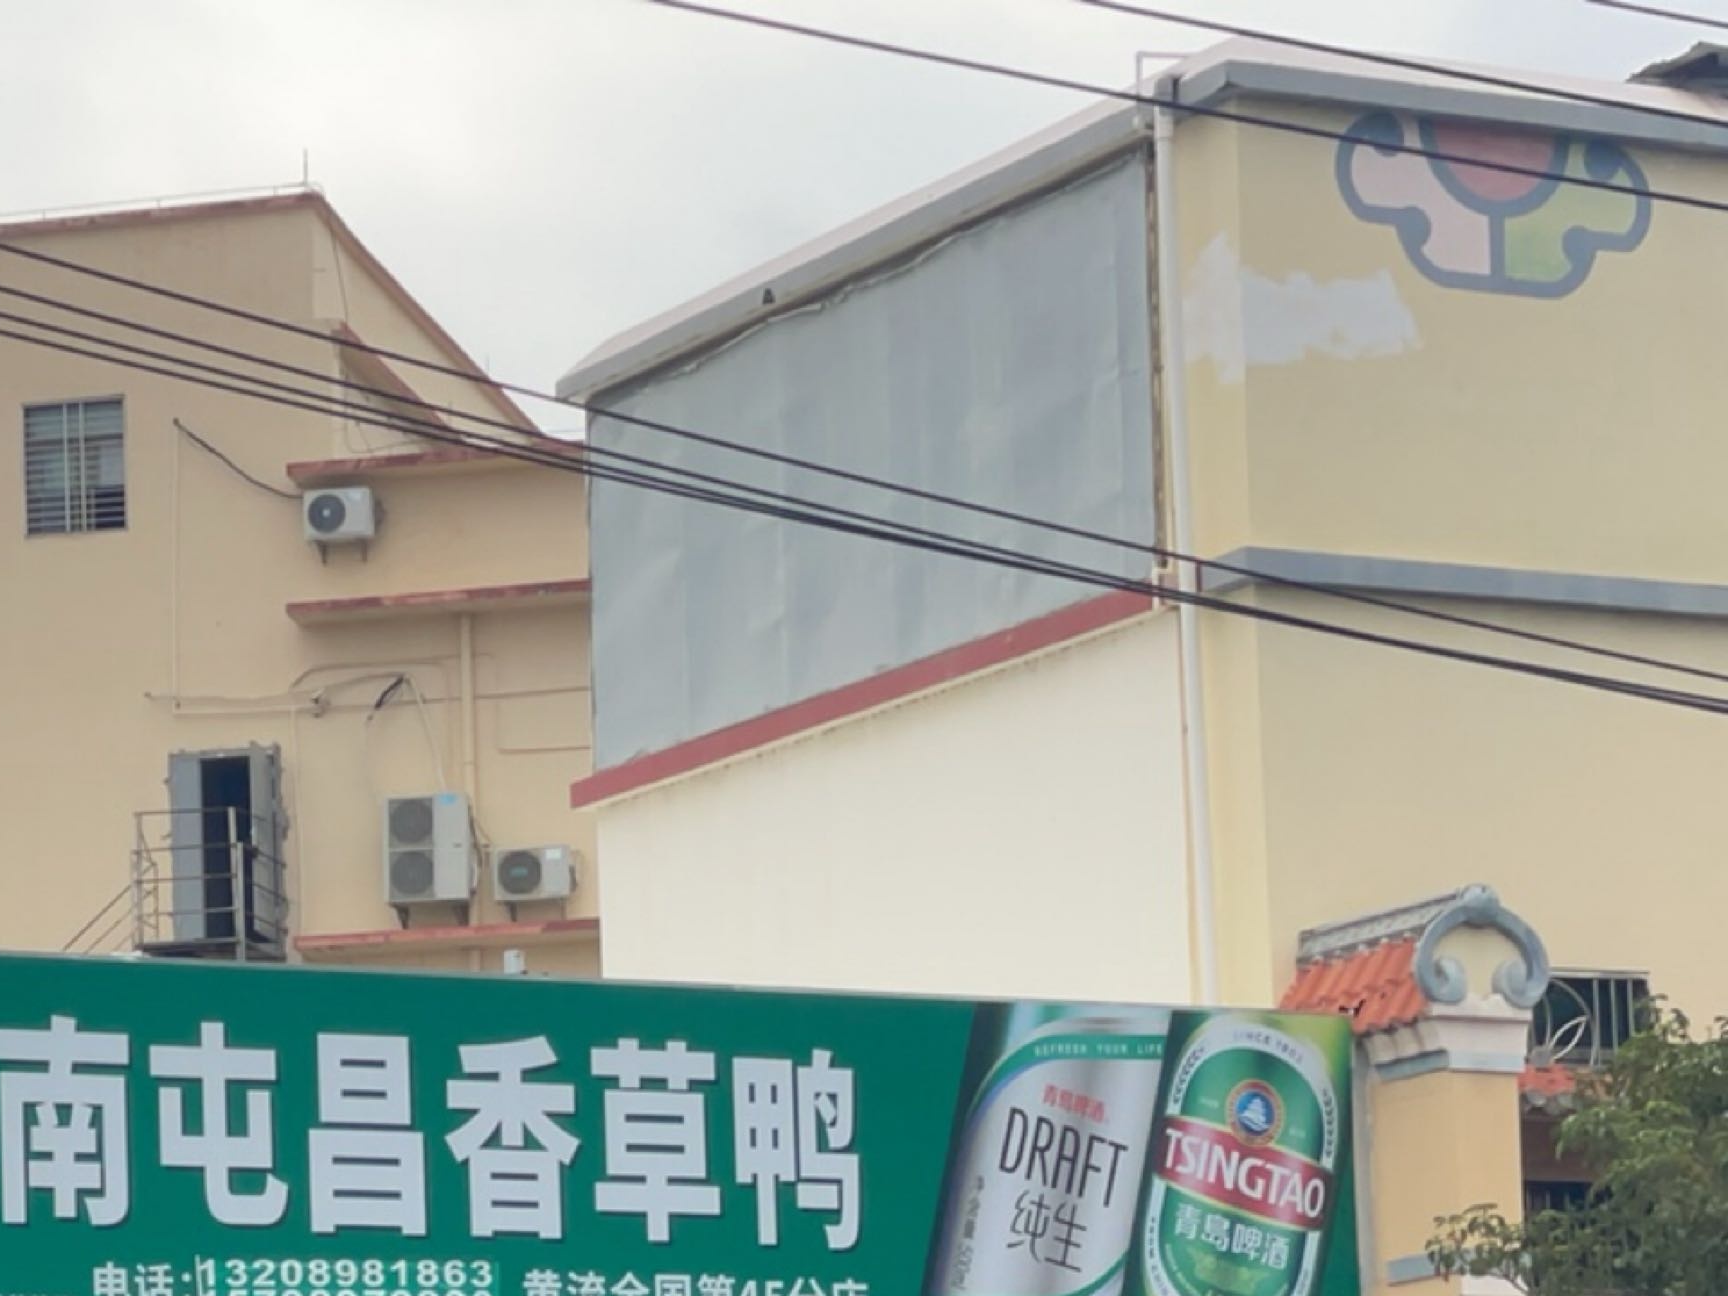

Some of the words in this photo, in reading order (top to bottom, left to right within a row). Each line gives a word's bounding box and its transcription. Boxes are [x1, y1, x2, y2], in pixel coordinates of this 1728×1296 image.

[999, 1106, 1129, 1209] DRAFT
[1165, 1127, 1326, 1229] TSINGTAO
[1006, 1190, 1088, 1273] 纯生
